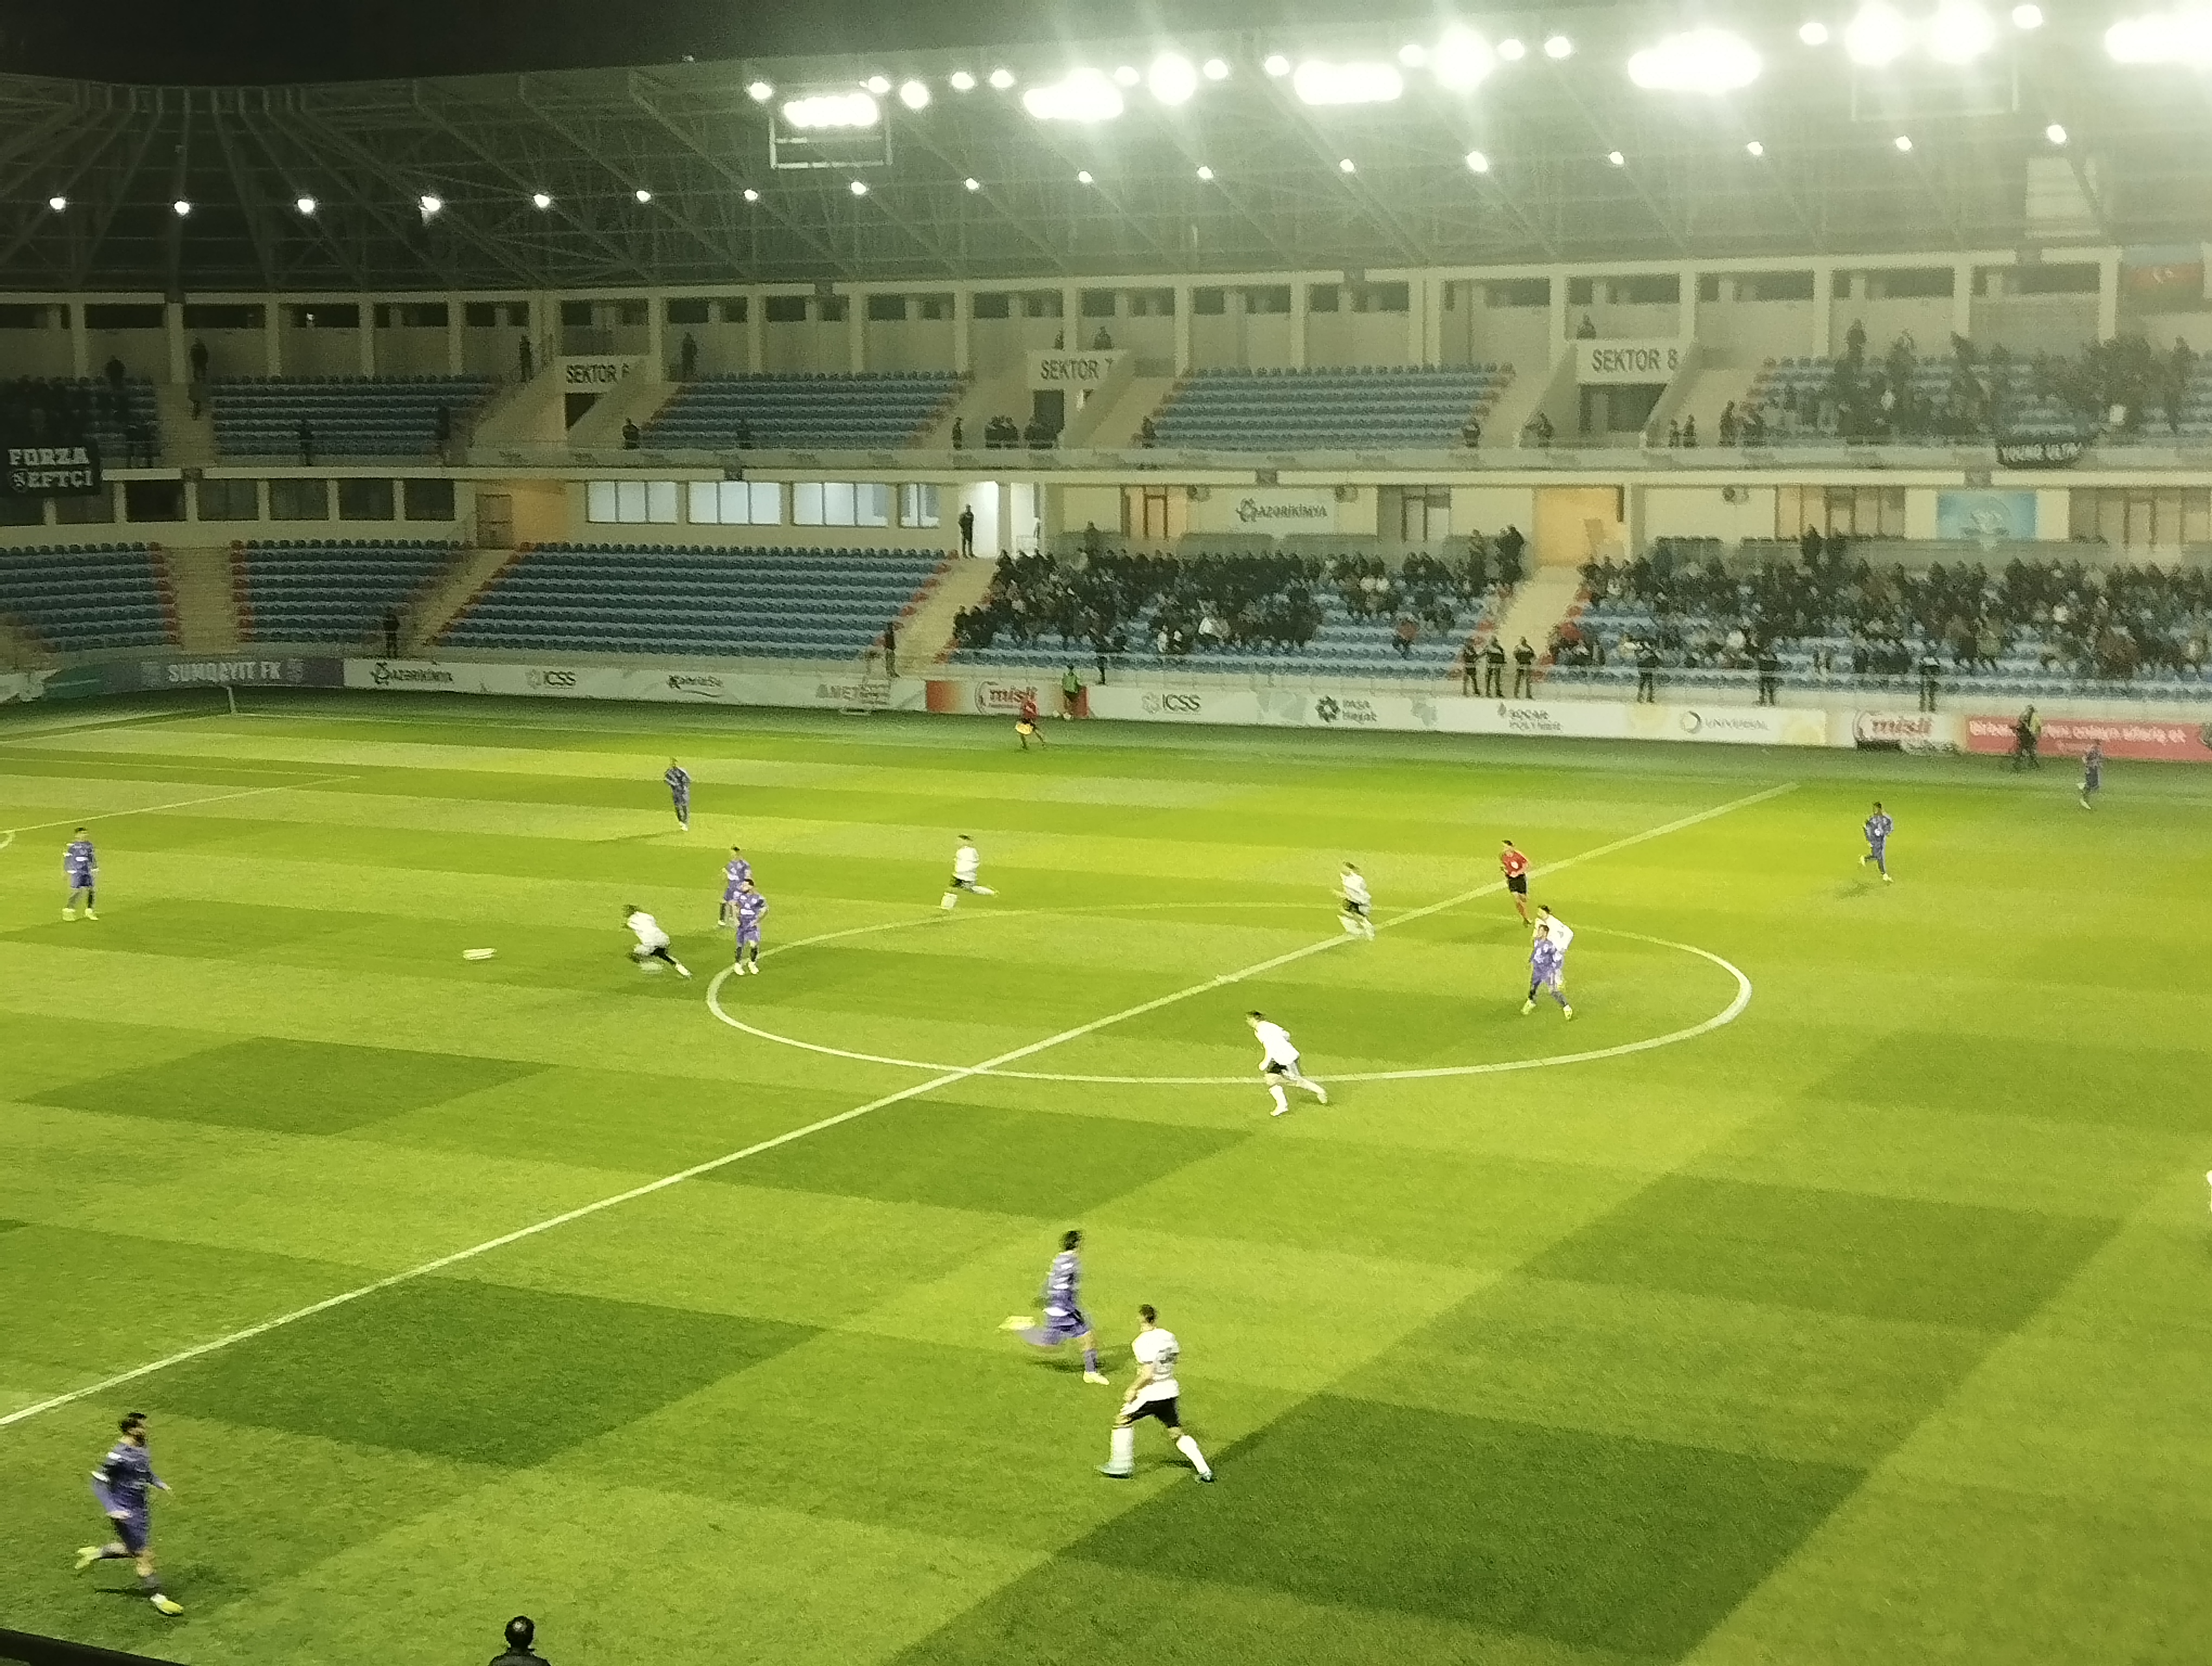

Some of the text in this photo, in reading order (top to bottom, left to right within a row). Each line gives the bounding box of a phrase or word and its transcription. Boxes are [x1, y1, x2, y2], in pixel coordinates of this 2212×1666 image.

[1040, 358, 1099, 380] SEKTOR
[1592, 348, 1678, 373] SEKTOR 8
[566, 363, 618, 384] SEKTOR
[8, 446, 90, 466] FORZA
[261, 661, 281, 680] FK
[1162, 693, 1201, 712] ICSS
